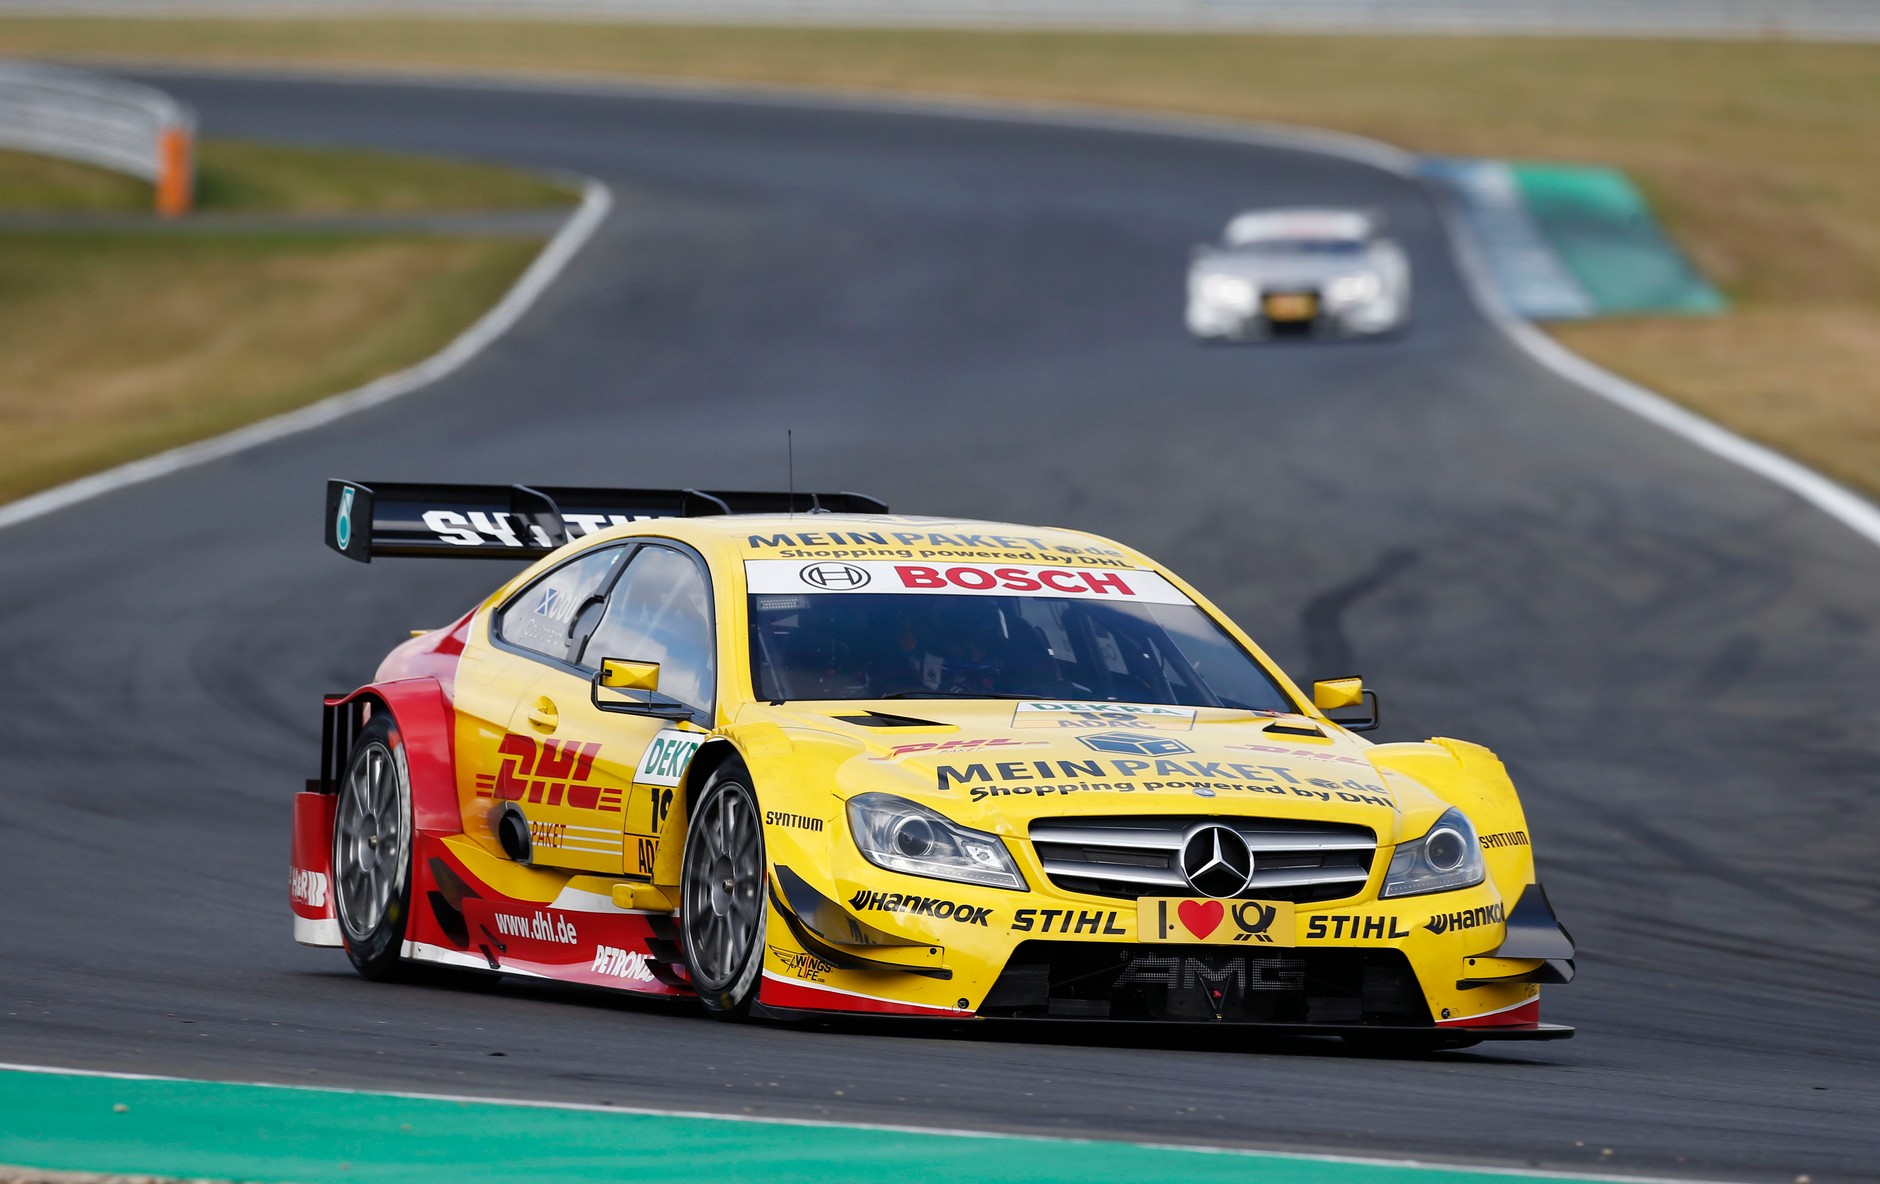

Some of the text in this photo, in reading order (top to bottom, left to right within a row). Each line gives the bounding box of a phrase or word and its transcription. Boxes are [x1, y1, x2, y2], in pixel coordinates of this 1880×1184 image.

[748, 532, 888, 548] MEIN
[891, 532, 1049, 551] PAKET
[780, 548, 1135, 568] Shopping powered by DHL
[894, 566, 1136, 596] BOSCH
[1030, 703, 1185, 716] DEKRA
[1070, 712, 1138, 721] 19
[1057, 720, 1157, 729] ADAC
[890, 738, 1023, 757] DHL
[1245, 744, 1371, 767] DHL
[493, 733, 603, 810] DHL
[937, 760, 1107, 790] MEIN
[1110, 759, 1302, 785] PAKET
[970, 781, 1136, 803] Shopping
[1142, 780, 1287, 795] powered
[1289, 786, 1331, 801] by
[765, 810, 824, 832] SYNTIUM
[532, 821, 567, 848] PAKET
[1479, 831, 1529, 849] SYNTIUM
[495, 911, 577, 944] www.dhl.de
[1011, 909, 1127, 935] STIHL
[1306, 915, 1410, 940] STIHL
[795, 954, 832, 974] WINGS
[797, 967, 819, 981] LIFE
[1112, 957, 1306, 990] AMG
